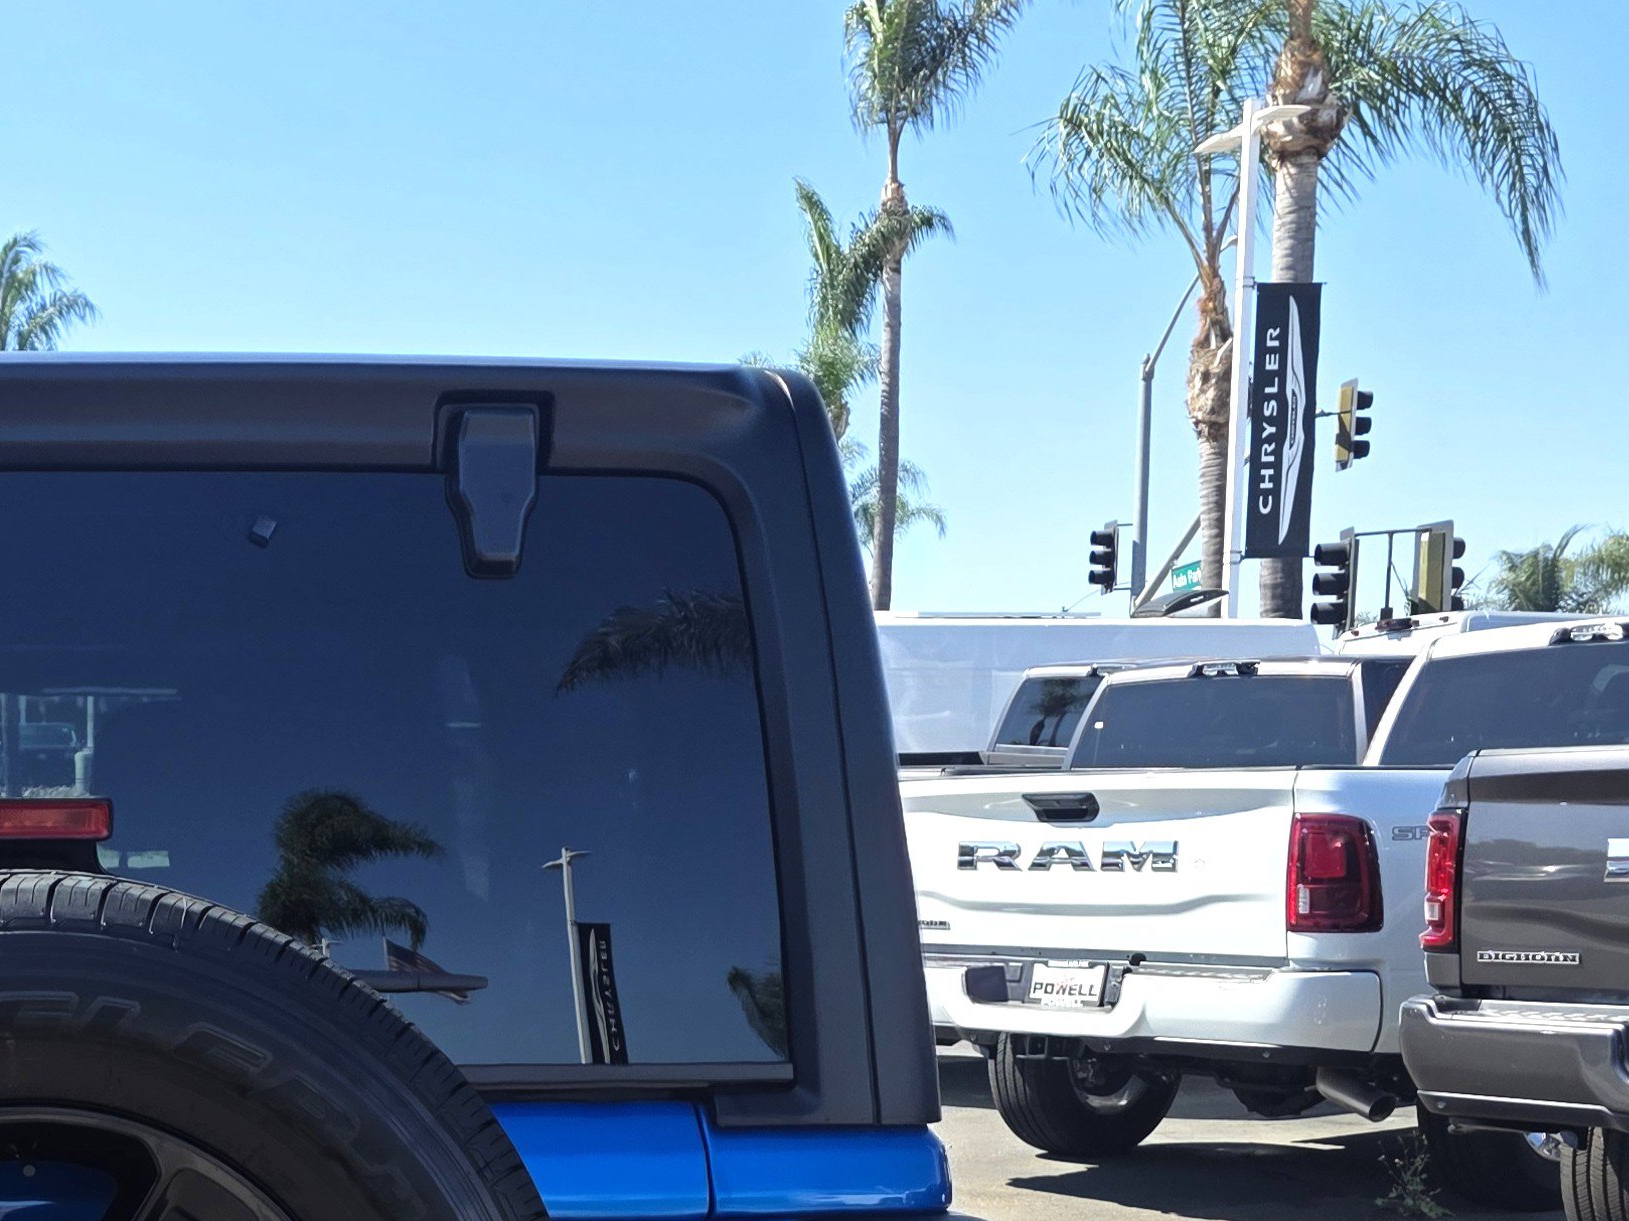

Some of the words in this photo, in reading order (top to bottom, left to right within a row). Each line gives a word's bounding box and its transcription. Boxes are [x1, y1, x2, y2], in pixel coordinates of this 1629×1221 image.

[1258, 326, 1281, 515] CHRYSLER
[957, 840, 1179, 872] RAM
[1033, 982, 1098, 997] POWELL
